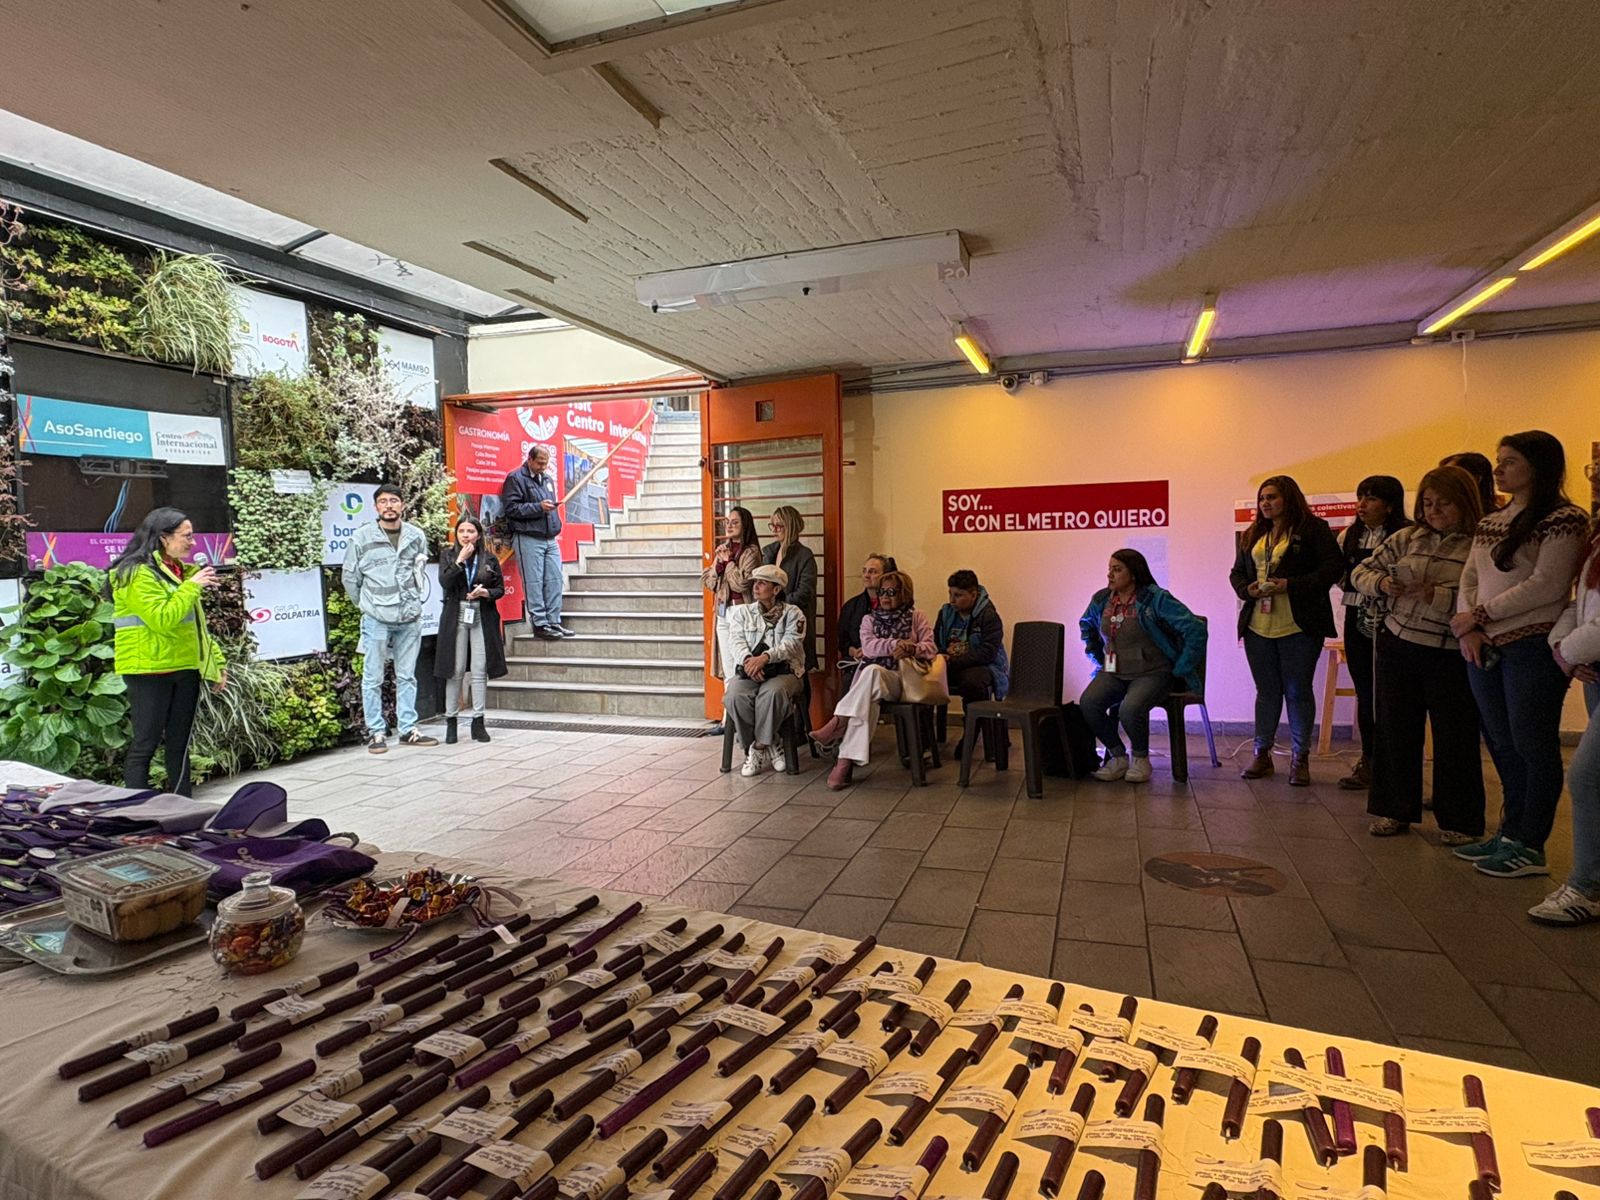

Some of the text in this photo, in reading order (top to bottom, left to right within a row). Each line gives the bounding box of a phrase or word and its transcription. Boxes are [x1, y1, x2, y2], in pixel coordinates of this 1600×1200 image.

[401, 362, 430, 375] MAMBO
[566, 410, 605, 433] Centro
[43, 420, 144, 444] AsoSandiego
[155, 431, 183, 441] Centro
[458, 425, 511, 442] GASTRONOMÍA
[156, 439, 218, 449] Internacional
[947, 494, 993, 512] SOY...
[1317, 503, 1356, 512] colectivas
[948, 508, 1166, 531] Y CON EL METRO QUIERO
[104, 545, 116, 553] SE
[274, 609, 321, 622] COLPATRIA
